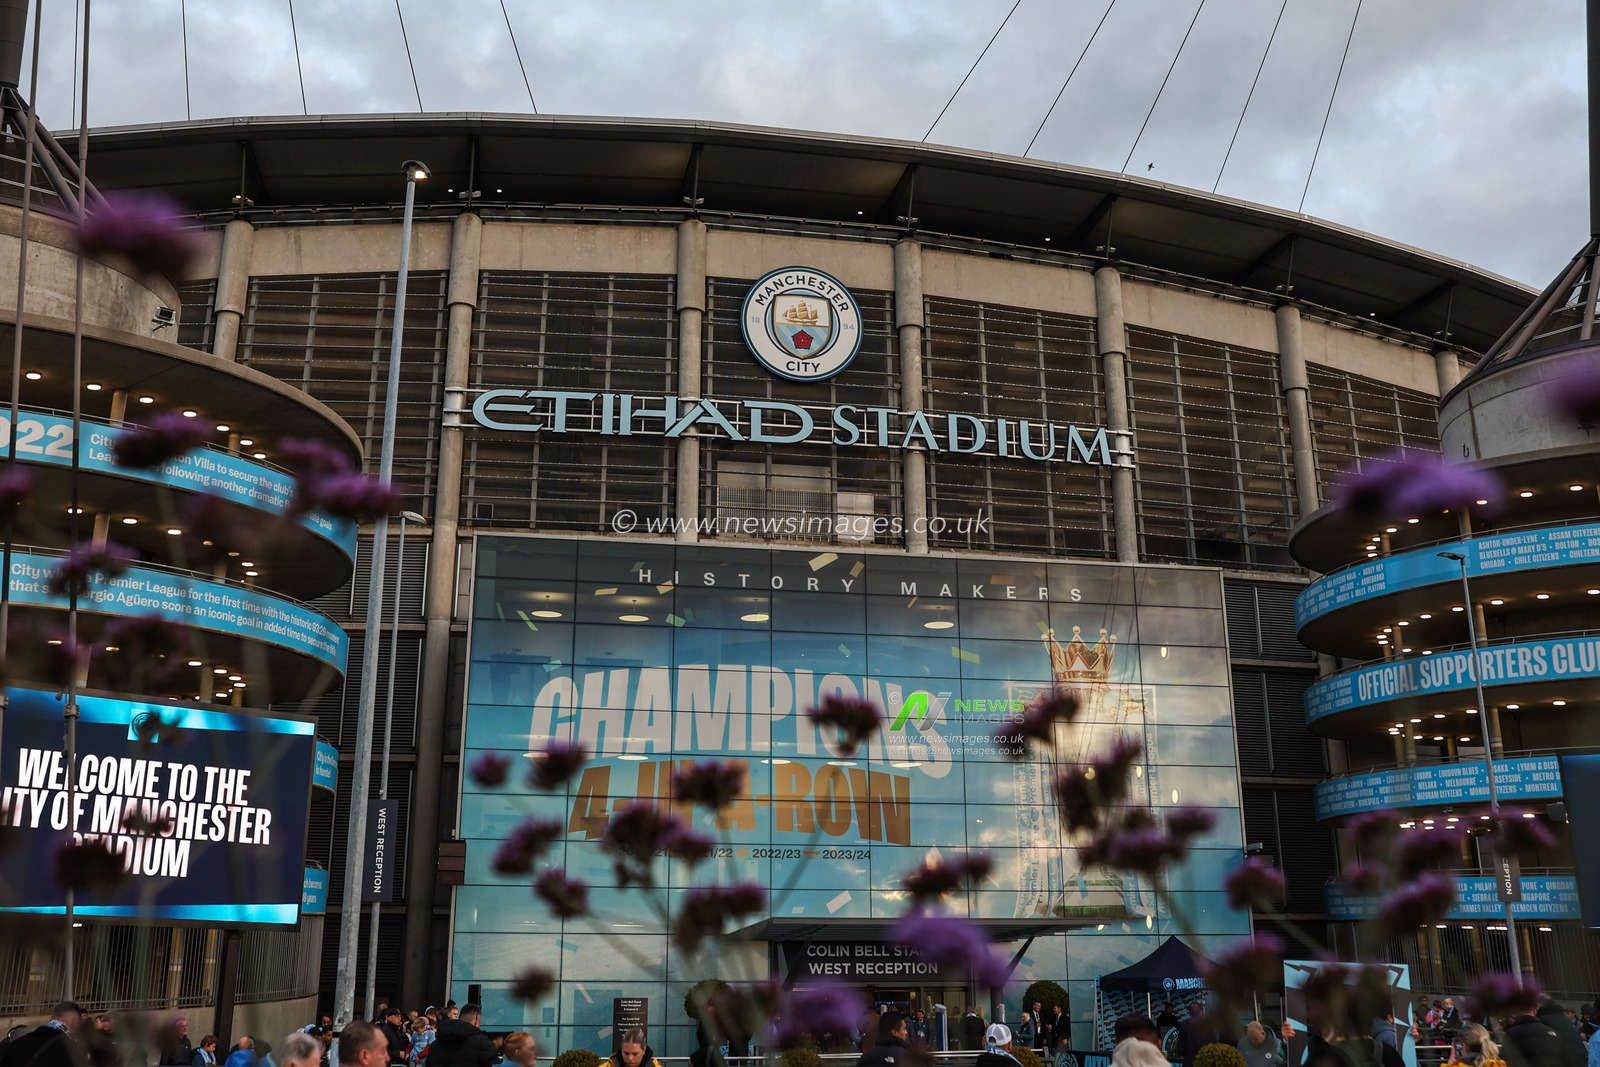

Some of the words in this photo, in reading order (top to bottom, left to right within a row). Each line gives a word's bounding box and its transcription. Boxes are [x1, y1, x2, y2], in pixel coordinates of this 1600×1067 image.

[755, 275, 849, 312] MANCHESTER
[786, 361, 820, 373] CITY
[472, 388, 814, 444] ETIHAD
[832, 404, 1112, 466] STADIUM
[89, 447, 120, 466] Leag
[161, 465, 210, 487] following
[211, 477, 248, 495] another
[248, 487, 284, 508] dramatic
[193, 455, 215, 472] Villa
[217, 464, 227, 475] to
[228, 467, 259, 485] secure
[259, 476, 273, 490] the
[1478, 534, 1538, 550] ASHTON-UNDER-LYNE
[1548, 530, 1571, 540] ASSAM
[1479, 547, 1511, 560] BLUEBELLS
[1517, 545, 1535, 554] MARY
[1555, 540, 1580, 550] BOLTON
[1588, 538, 1600, 547] BOS
[1480, 559, 1505, 570] CHICAGO
[1514, 555, 1531, 565] CHILE
[1532, 552, 1560, 563] CITIZENS
[11, 563, 40, 579] City
[94, 573, 144, 590] Premier
[146, 580, 187, 598] League
[188, 588, 203, 601] for
[204, 592, 220, 605] the
[221, 595, 241, 609] first
[242, 600, 261, 615] time
[261, 605, 279, 619] with
[279, 609, 290, 622] the
[290, 613, 312, 631] historic
[638, 567, 855, 593] HISTORY
[901, 581, 1081, 602] MAKERS
[9, 580, 39, 593] that
[78, 586, 115, 603] ergio
[116, 591, 160, 609] Agüero
[162, 601, 192, 614] score
[194, 607, 207, 617] an
[208, 607, 236, 623] iconic
[237, 614, 255, 628] goal
[255, 618, 263, 629] in
[264, 621, 286, 636] added
[287, 627, 301, 641] time
[301, 632, 308, 643] to
[1358, 663, 1418, 701] OFFICIAL
[1419, 646, 1548, 689] SUPPORTERS
[1552, 641, 1600, 675] CLU
[529, 664, 953, 779] CHAMPIONS
[1445, 777, 1476, 787] MELBOURNE
[1486, 773, 1522, 784] MRSEYSIDE
[1532, 771, 1554, 781] METRO
[1462, 766, 1479, 775] BLUES
[1516, 761, 1537, 772] LYMM
[1543, 760, 1559, 770] DIST
[167, 762, 199, 803] TO
[203, 766, 251, 806] THE
[1494, 784, 1517, 794] TYZENS
[1525, 783, 1558, 792] MONTREAL
[0, 786, 50, 829] ITY
[50, 790, 89, 832] OF
[91, 794, 272, 845] MANCHESTER
[377, 807, 386, 835] WEST
[67, 832, 191, 878] DIUM
[373, 838, 384, 893] RECEPTION
[752, 848, 801, 859] 2022/23
[822, 849, 871, 860] 2023/24
[1502, 857, 1512, 895] CEPTION
[1521, 881, 1537, 890] PUNE
[1546, 881, 1574, 891] QINGDAO
[1481, 903, 1502, 912] VALLEY
[1539, 903, 1568, 912] CITYZENS
[1521, 892, 1550, 902] NGAPORE
[807, 945, 850, 957] COLIN
[855, 945, 890, 957] BELL
[894, 945, 923, 957] STA
[809, 963, 851, 974] WEST
[856, 962, 938, 974] RECEPTION
